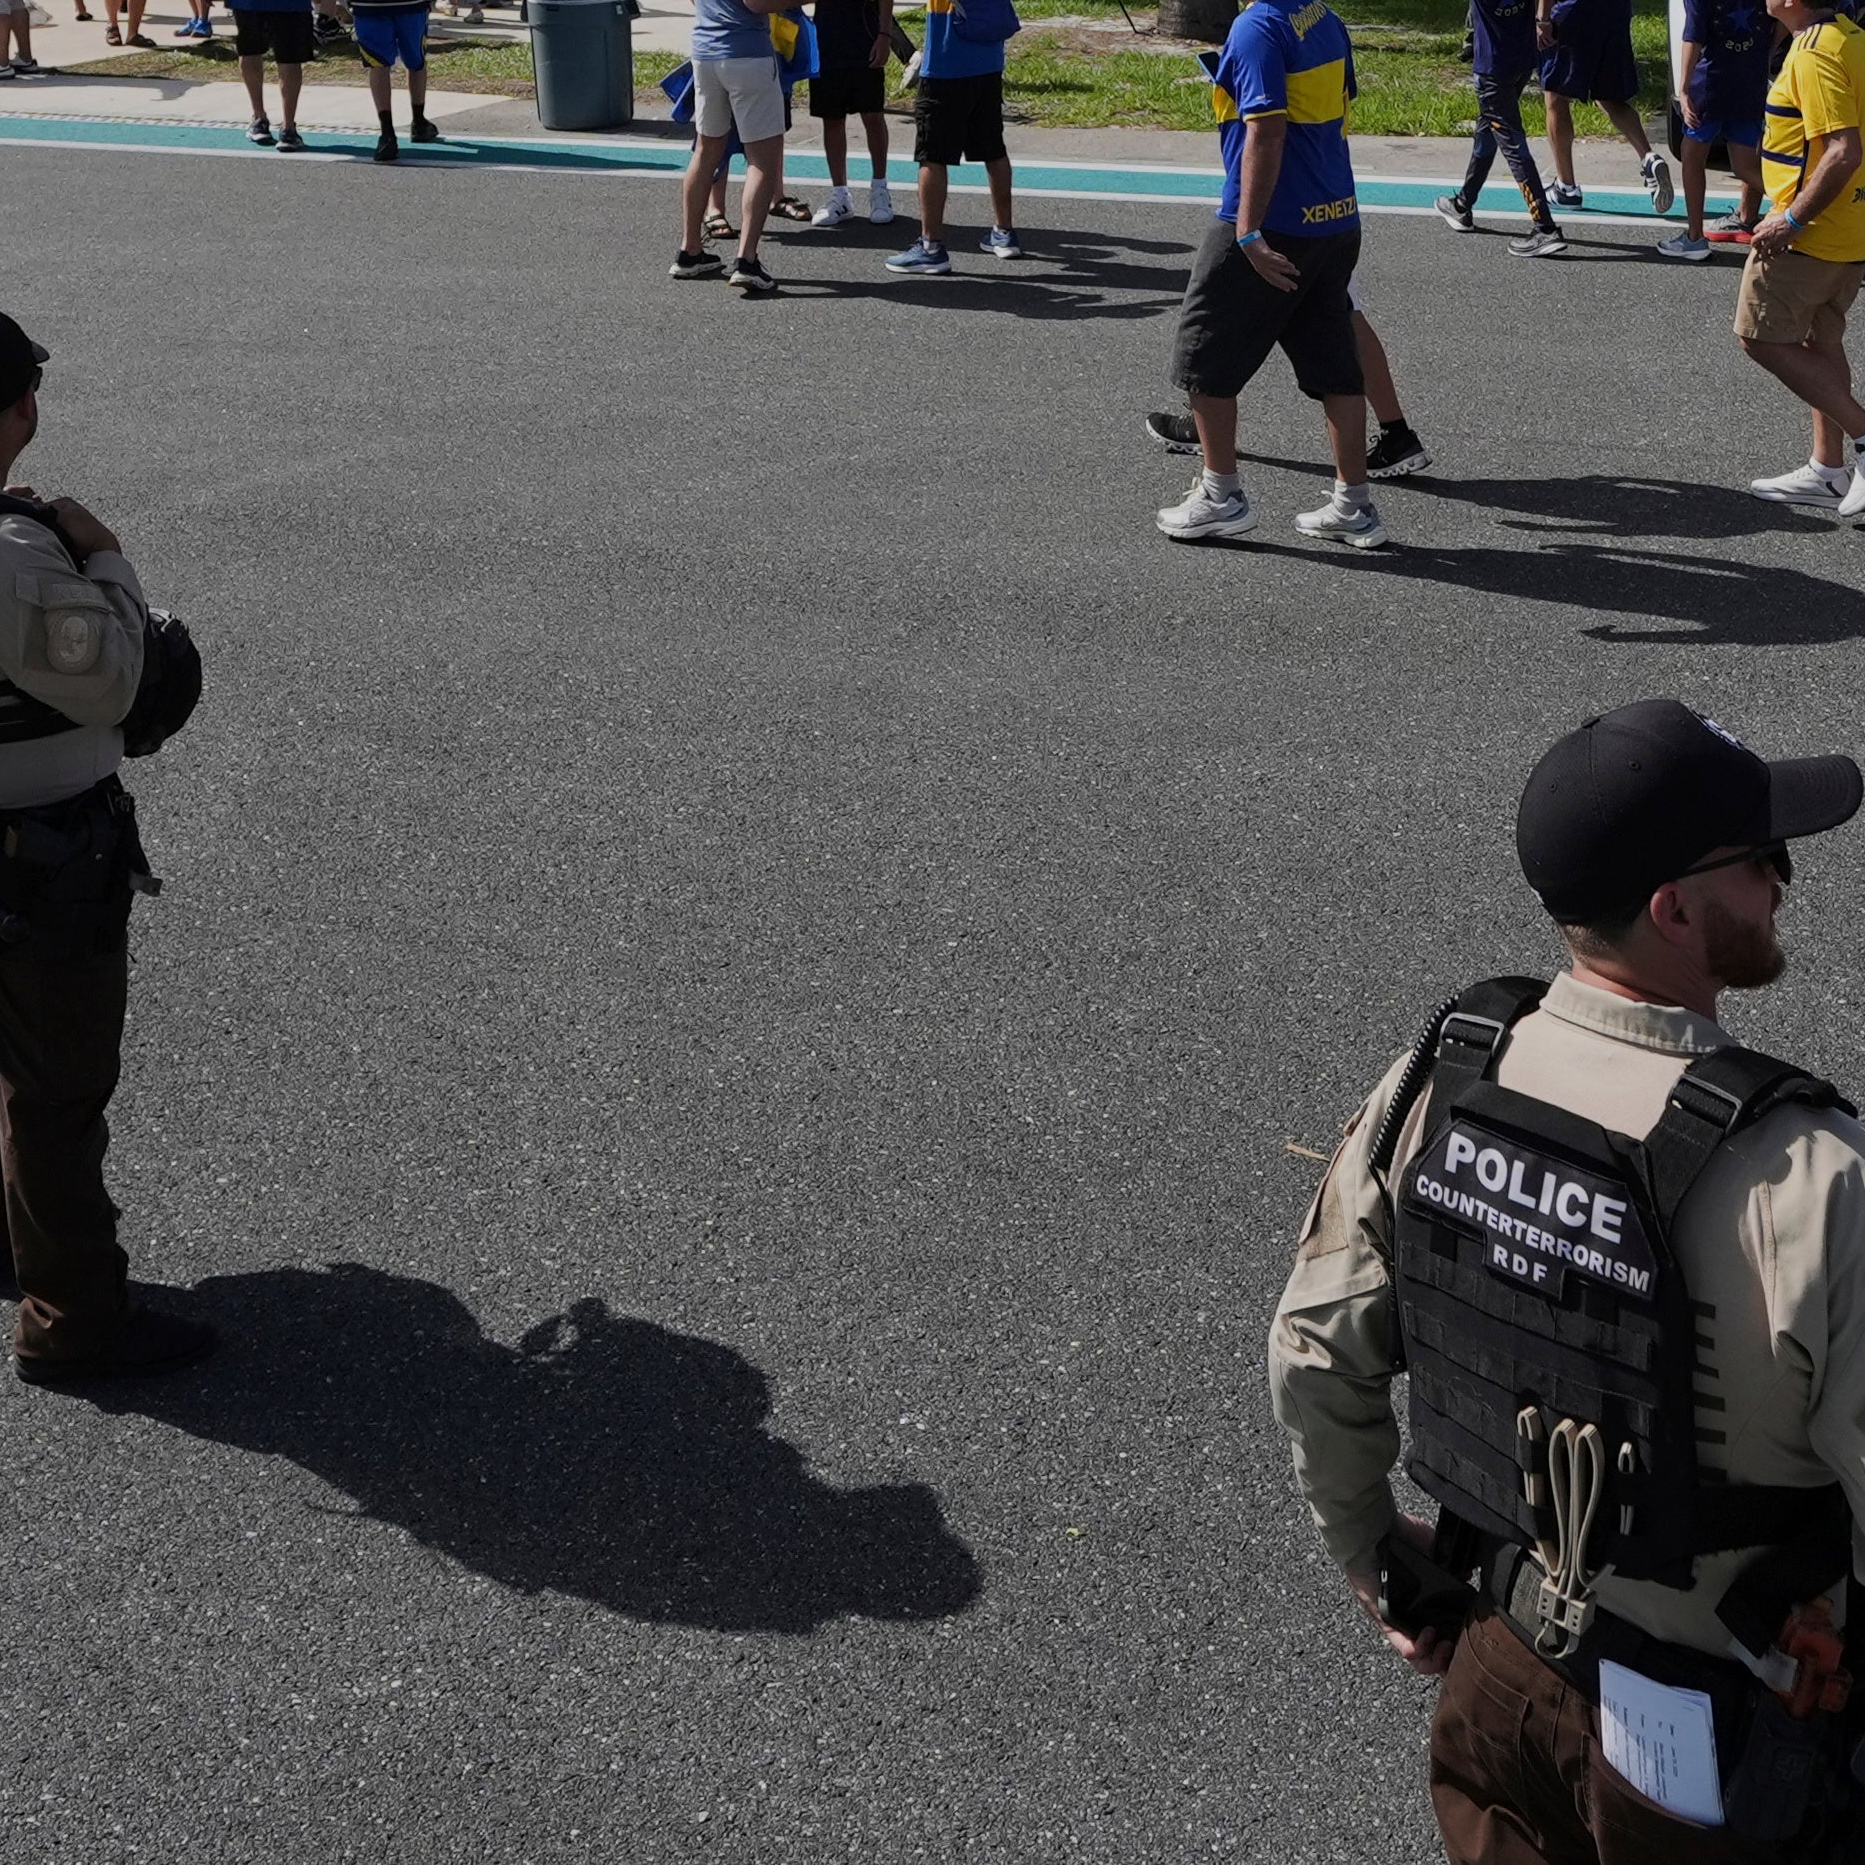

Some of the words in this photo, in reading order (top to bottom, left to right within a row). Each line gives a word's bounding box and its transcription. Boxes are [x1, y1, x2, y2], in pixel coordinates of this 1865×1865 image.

[1301, 195, 1357, 224] XENEIZ
[1444, 1130, 1628, 1245] POLICE
[1416, 1173, 1651, 1293] COUNTERTERRORISM
[1492, 1243, 1548, 1283] RDF
